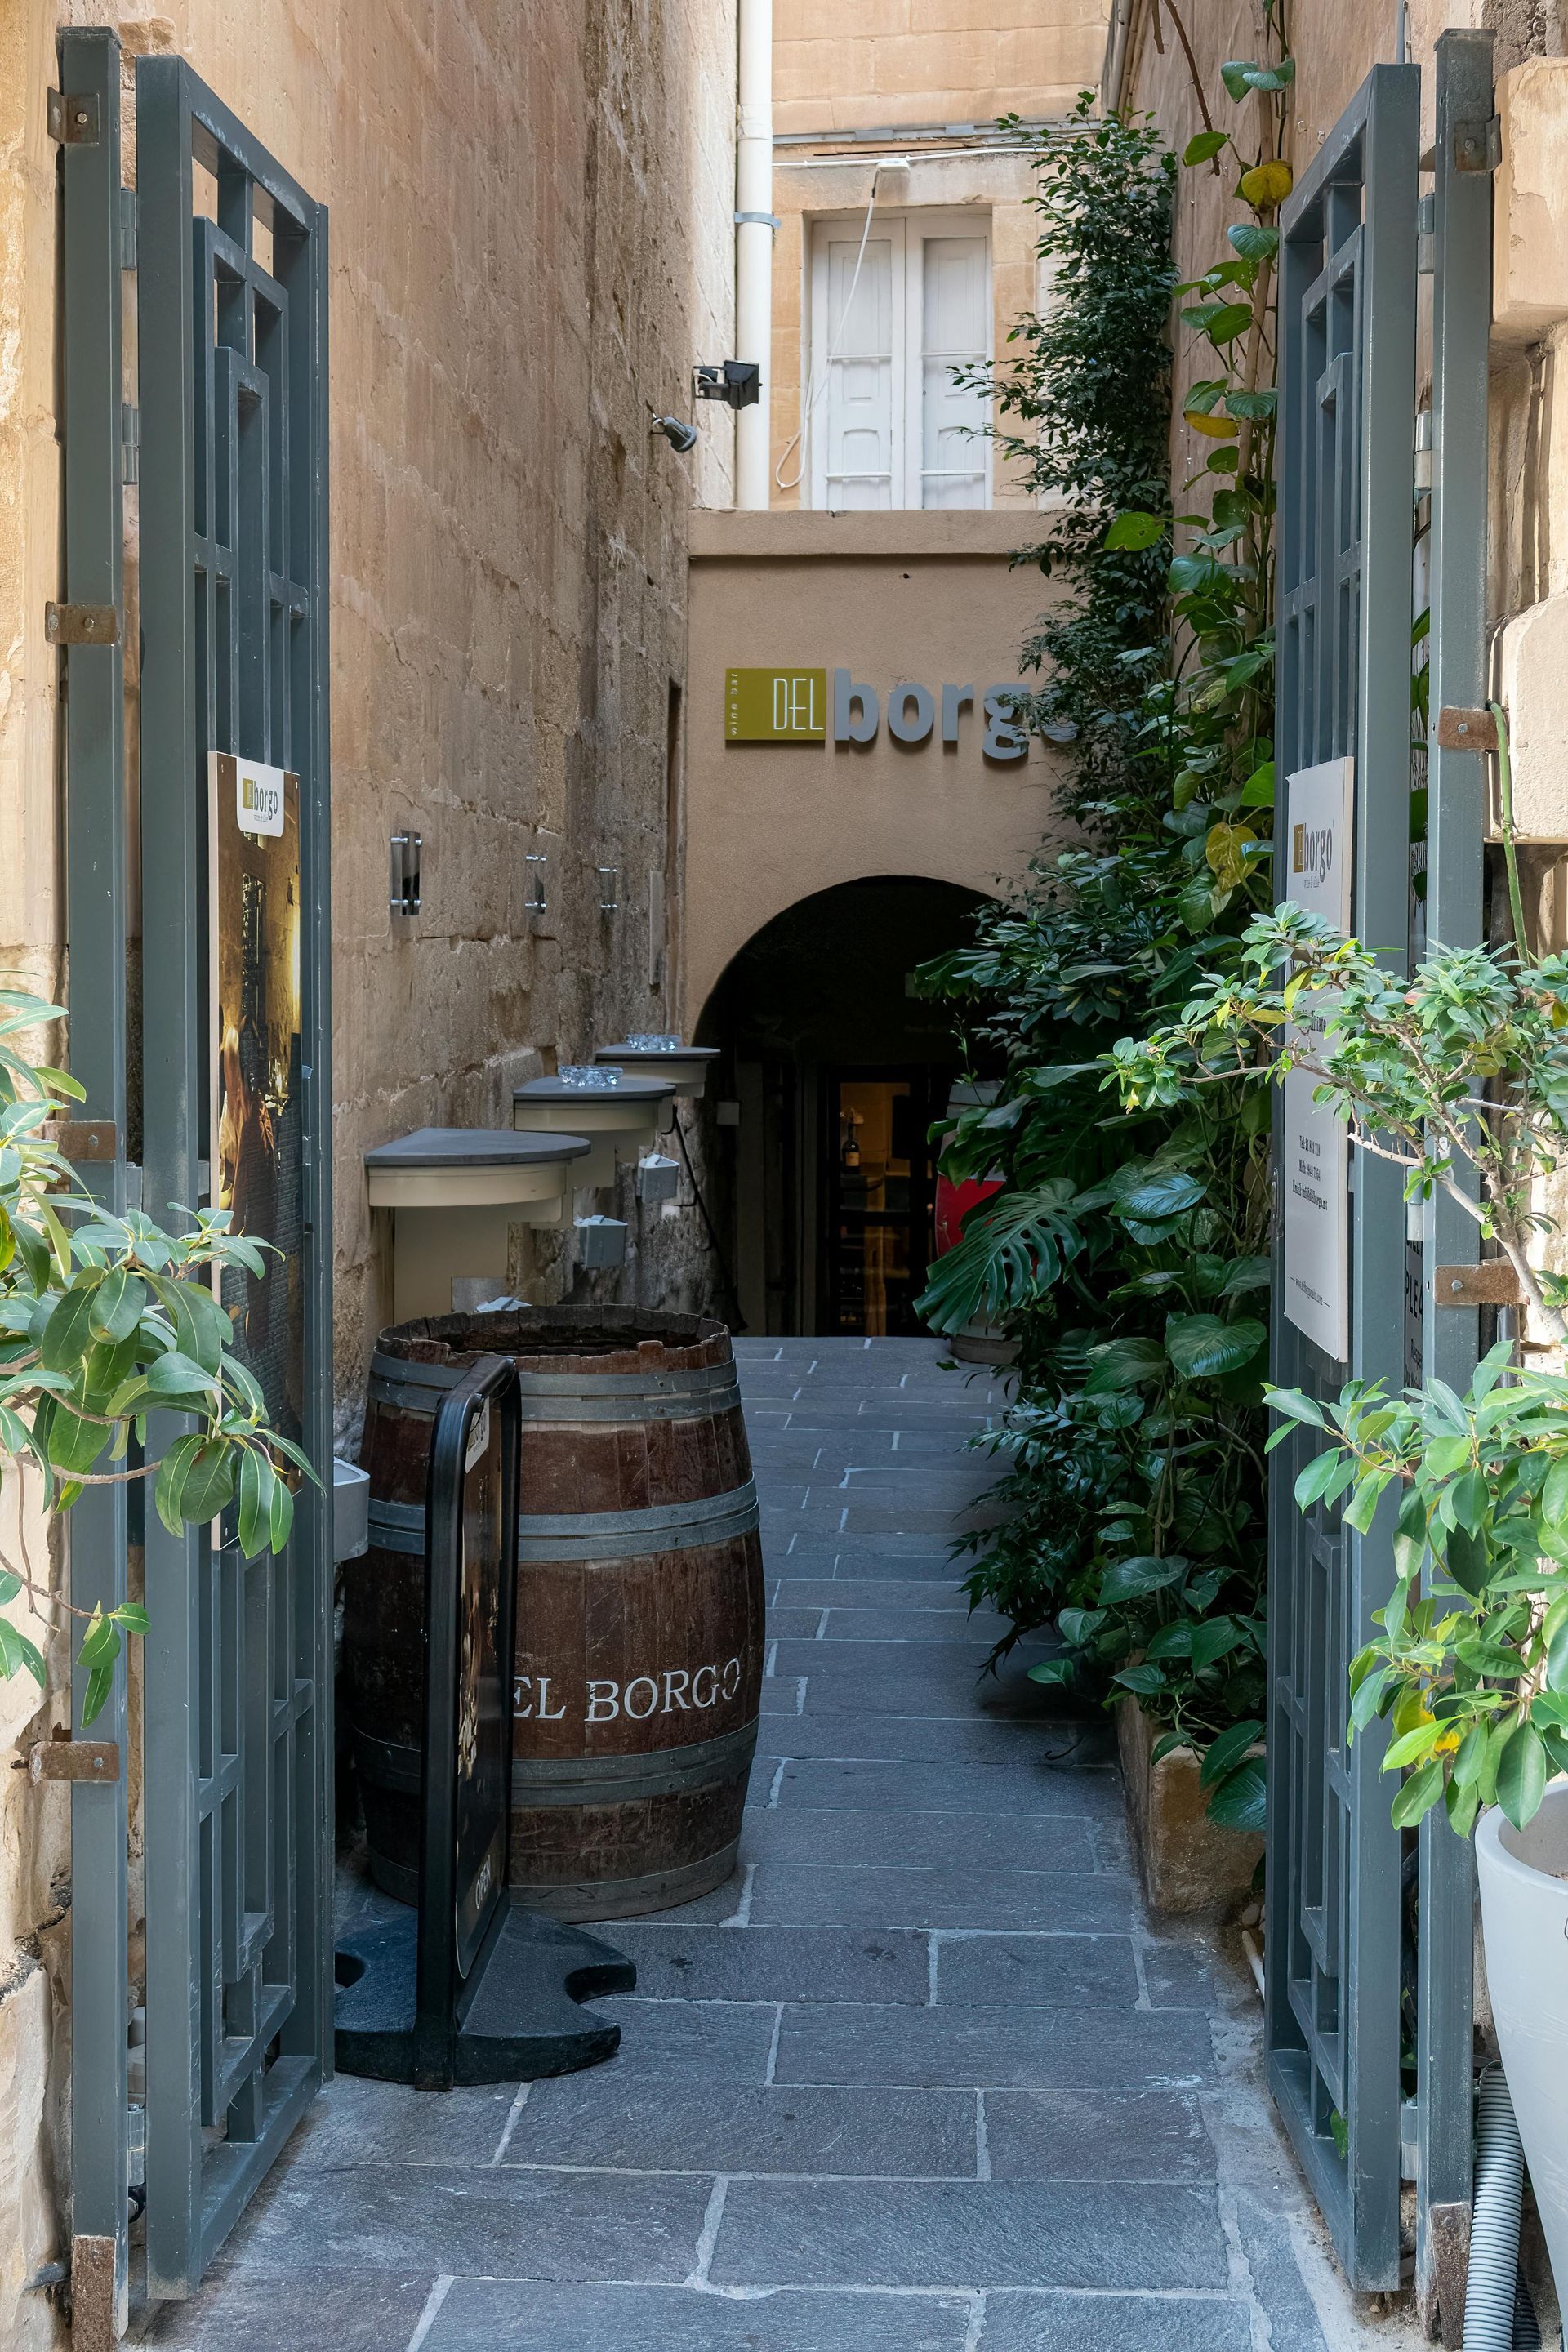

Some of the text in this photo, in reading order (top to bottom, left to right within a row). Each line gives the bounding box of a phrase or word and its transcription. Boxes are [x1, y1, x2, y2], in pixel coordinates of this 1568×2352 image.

[773, 678, 824, 730] DEL
[254, 781, 278, 821] borgo
[1304, 822, 1333, 883] borgo
[583, 1657, 741, 1722] BORGO
